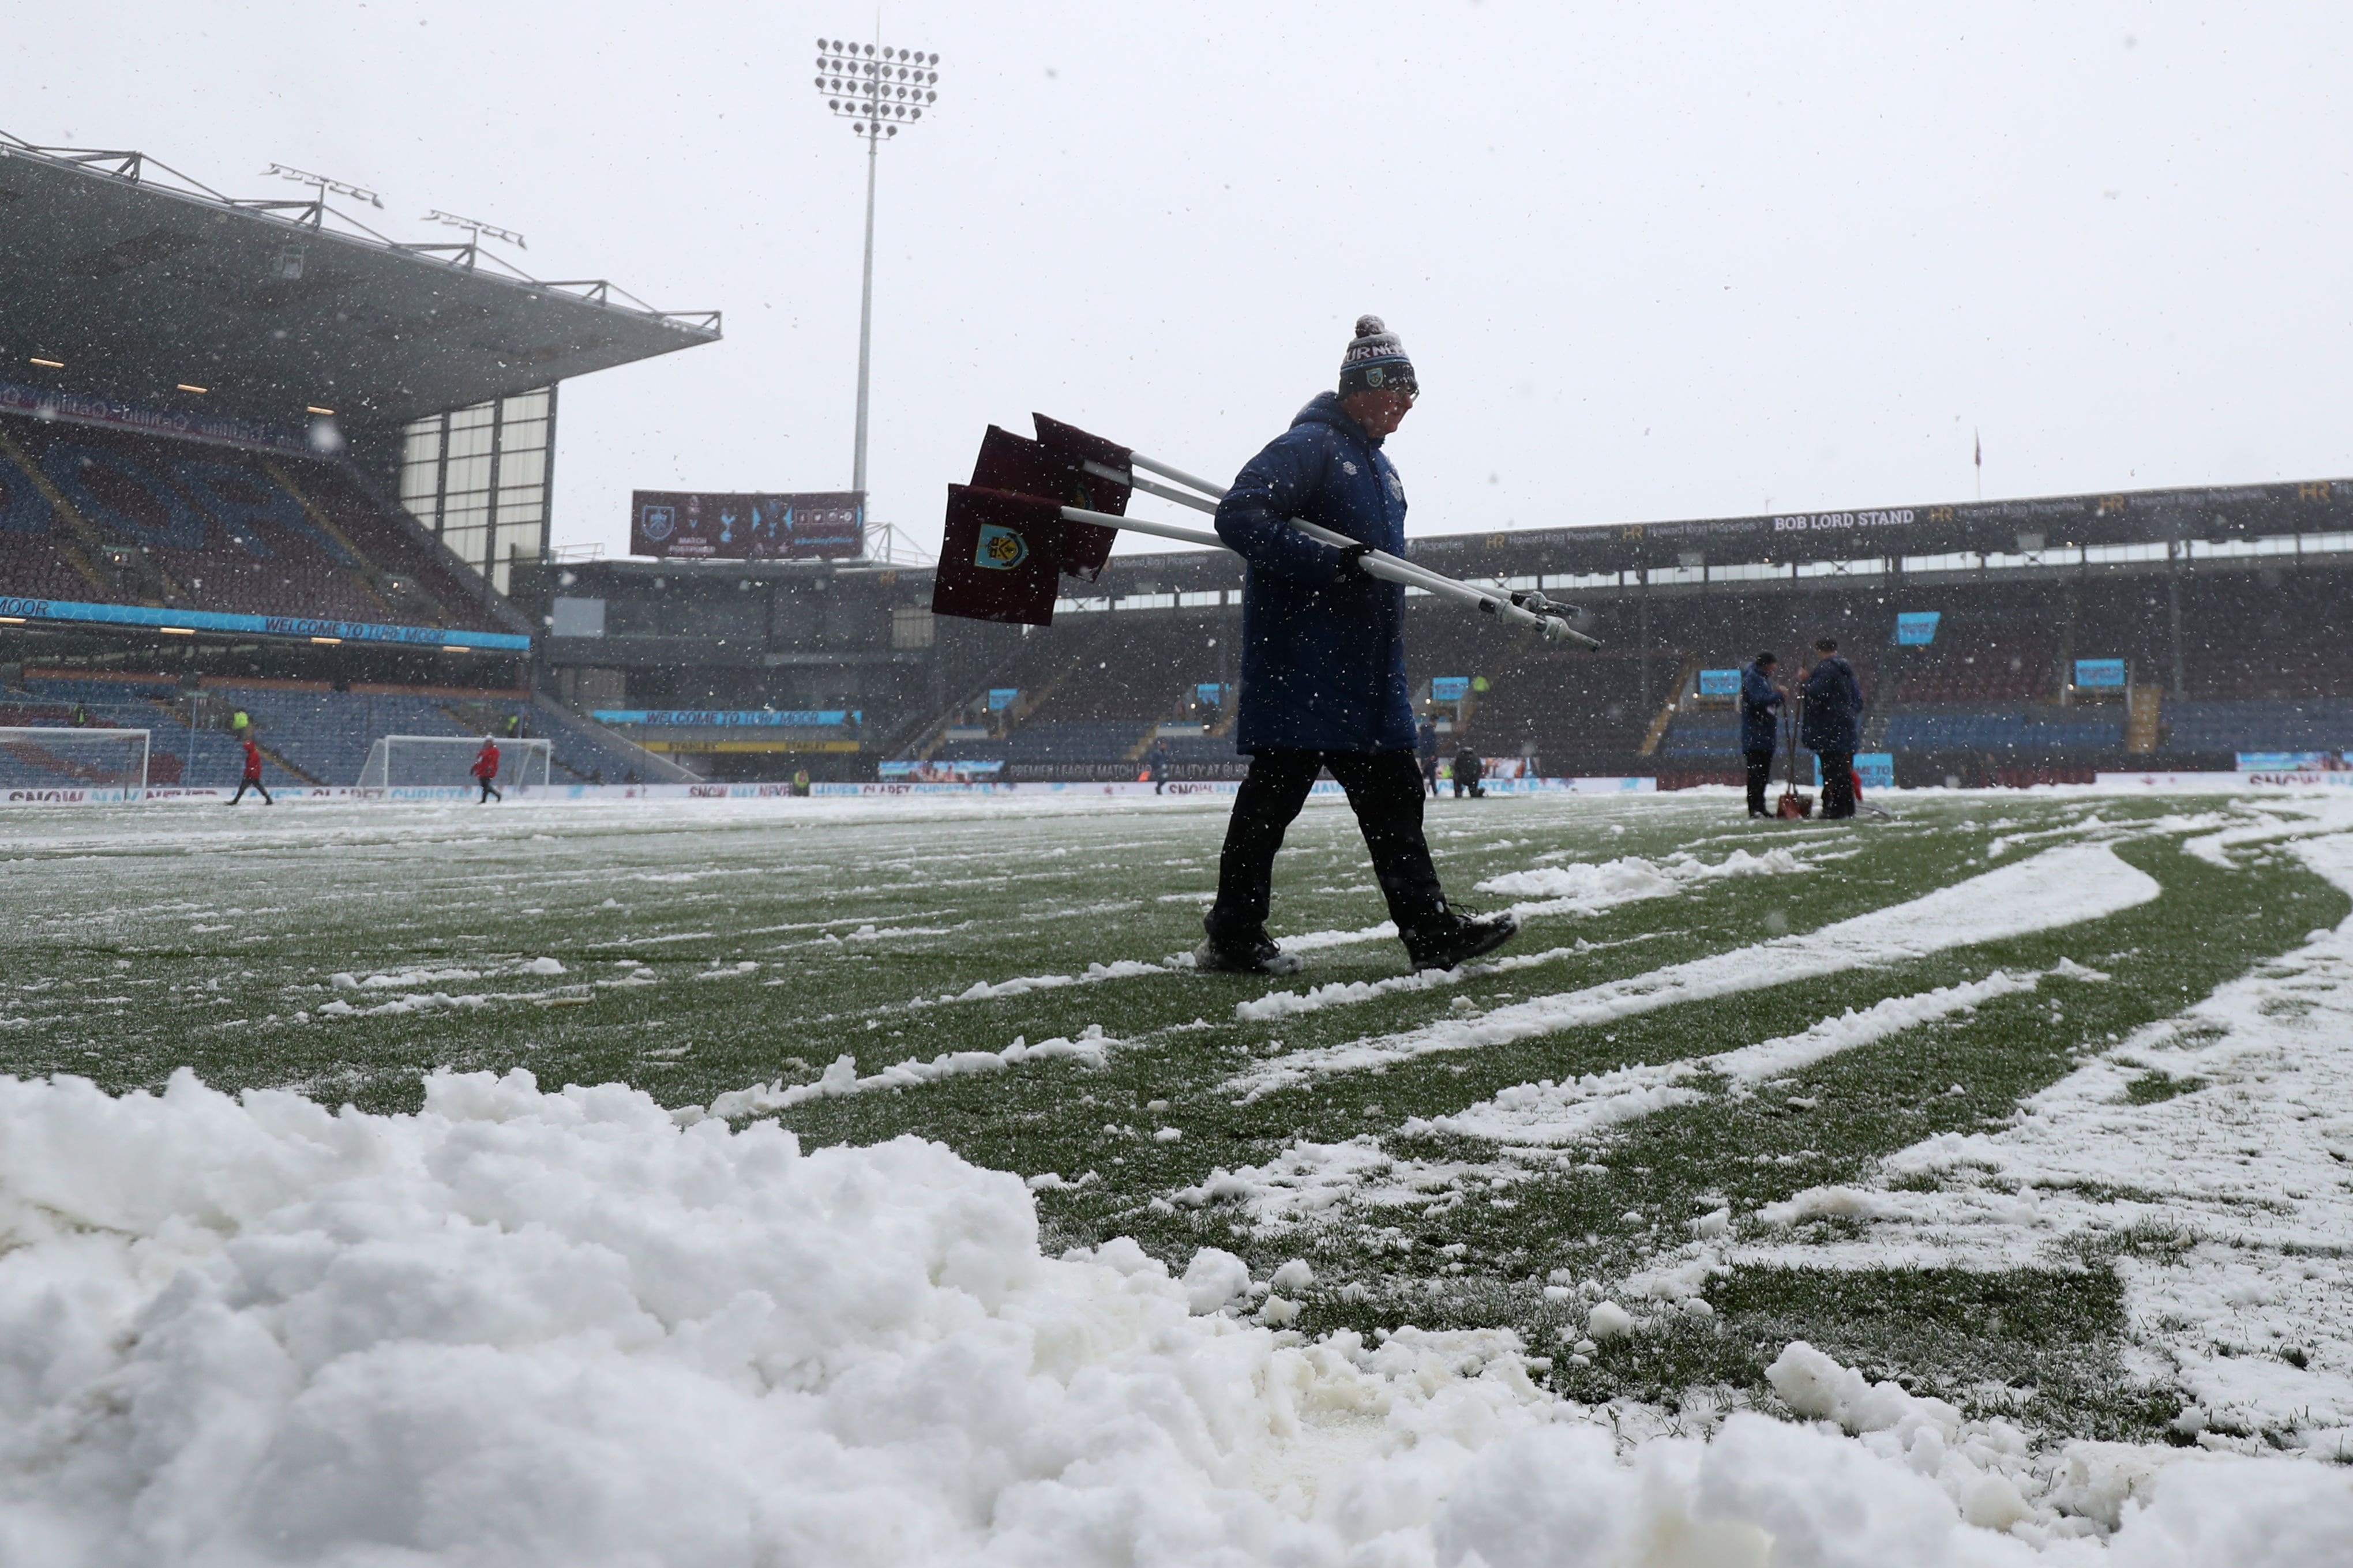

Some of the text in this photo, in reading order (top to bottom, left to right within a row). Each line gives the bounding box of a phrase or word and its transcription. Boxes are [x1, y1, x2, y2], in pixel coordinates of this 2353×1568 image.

[1774, 509, 1914, 531] BOB LORD STAND
[1648, 525, 1684, 536] Howard
[1710, 521, 1757, 533] Properties
[1509, 535, 1543, 545] Howard
[1545, 533, 1566, 546] Rigg
[1567, 529, 1611, 542] Properties
[265, 618, 446, 642] WELCOME TO TURF MOOR
[646, 712, 819, 724] WELCOME TO TURF MOOR
[1011, 765, 1053, 776] PREMIER
[1098, 764, 1134, 776] MATCH
[689, 785, 728, 797] SNOW
[1169, 784, 1213, 794] SNOW
[9, 790, 85, 802] SNOW
